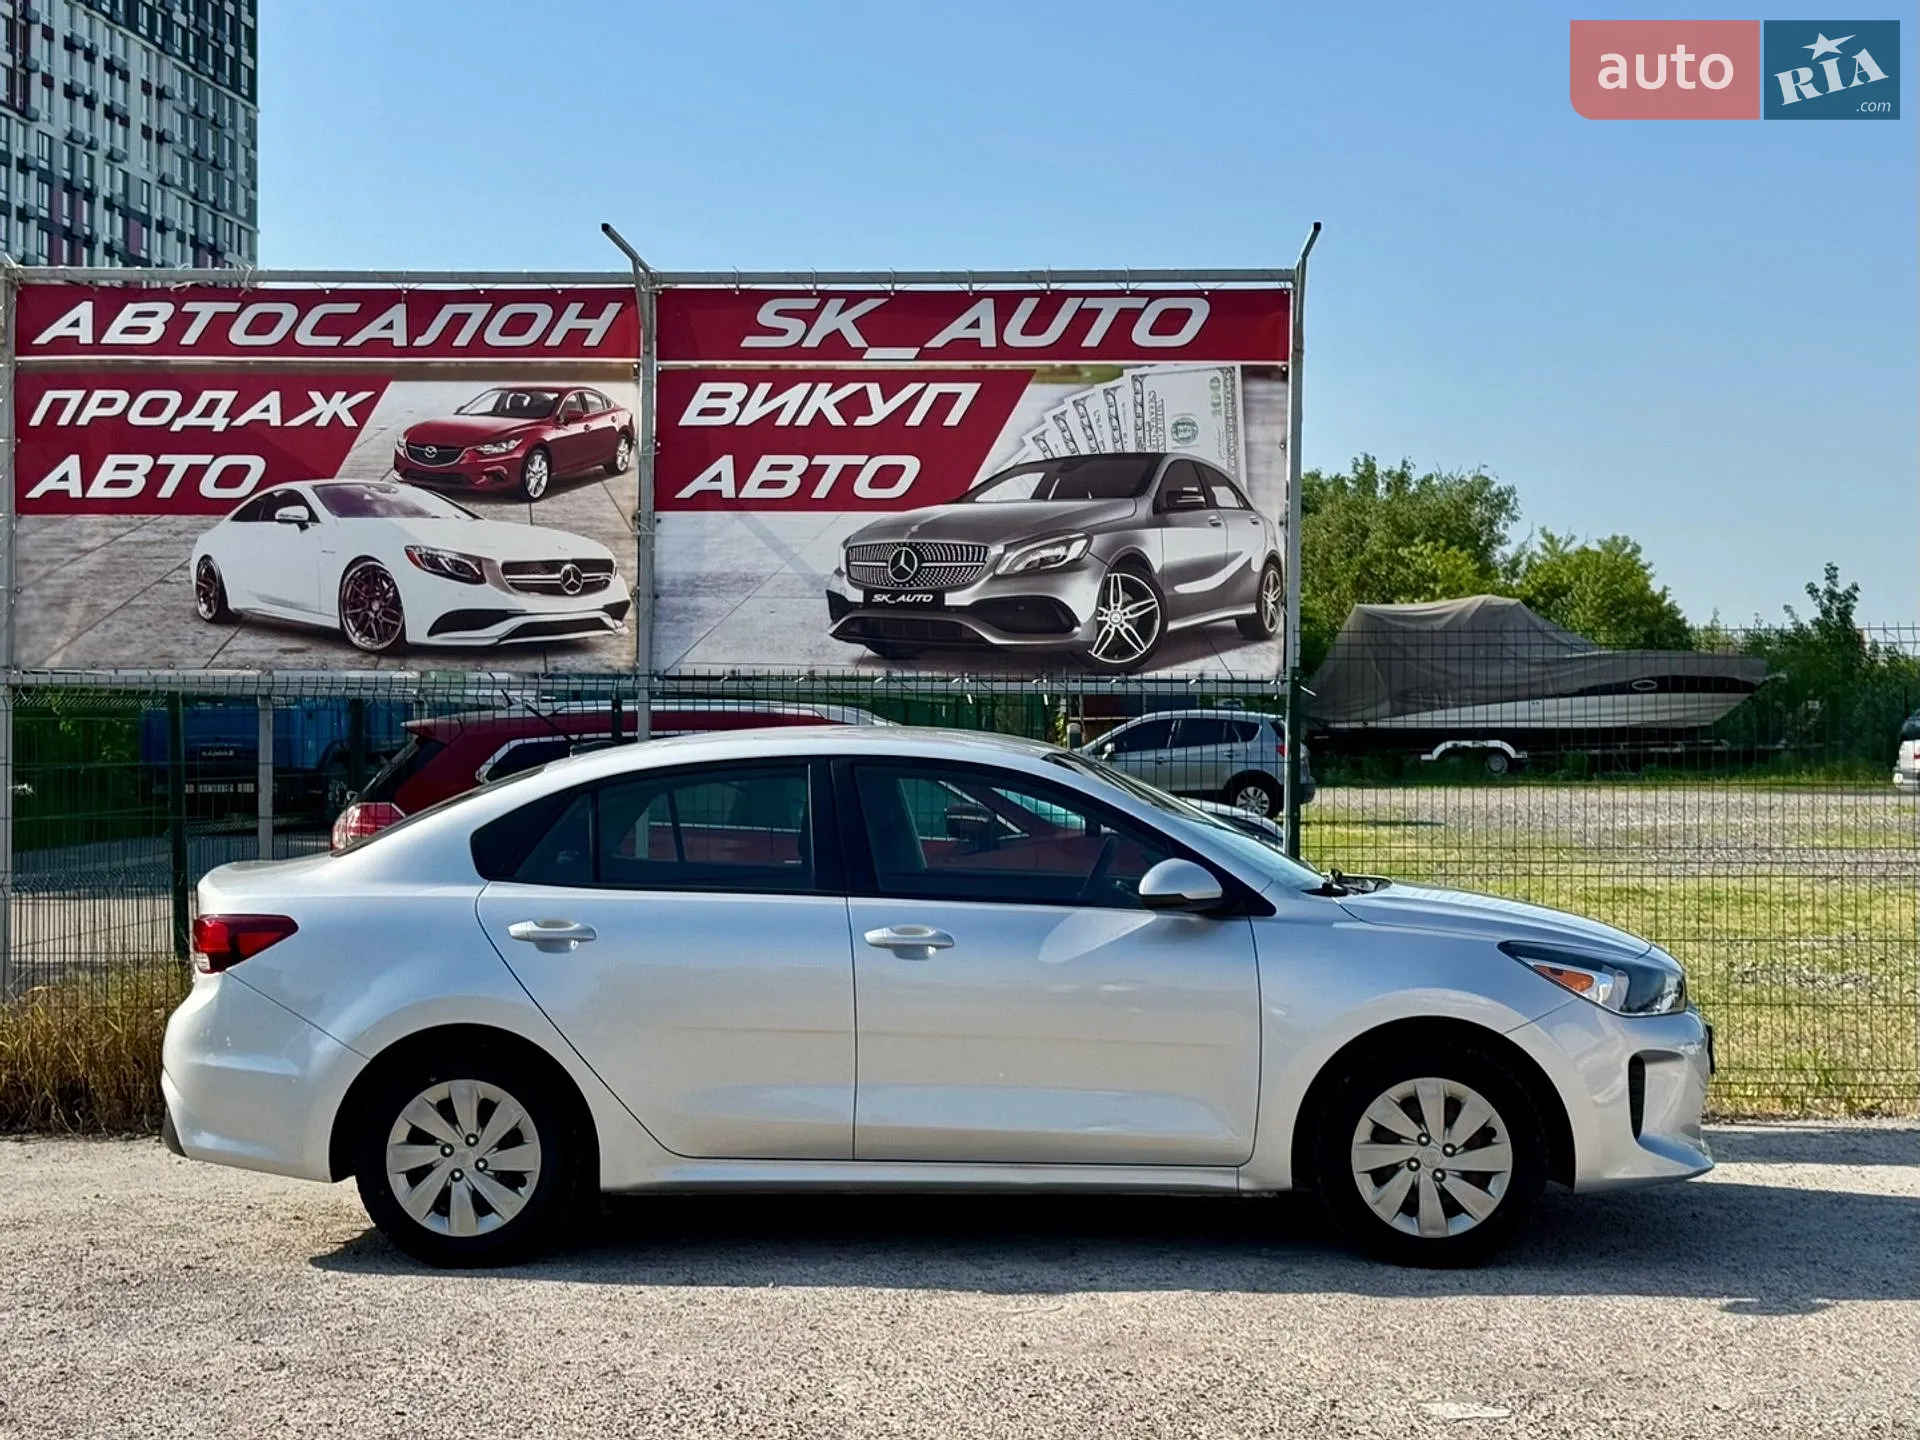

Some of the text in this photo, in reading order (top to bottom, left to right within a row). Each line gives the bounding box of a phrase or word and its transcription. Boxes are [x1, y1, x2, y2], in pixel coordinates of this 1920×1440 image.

[32, 301, 623, 347] АВТОСАЛОН
[740, 298, 1210, 360] SK_AUTO
[29, 390, 374, 432] ПРОДАЖ
[678, 382, 982, 427] ВИКУП
[26, 455, 266, 499] АВТО
[675, 455, 921, 499] АВТО
[871, 593, 934, 604] SK_AUTO
